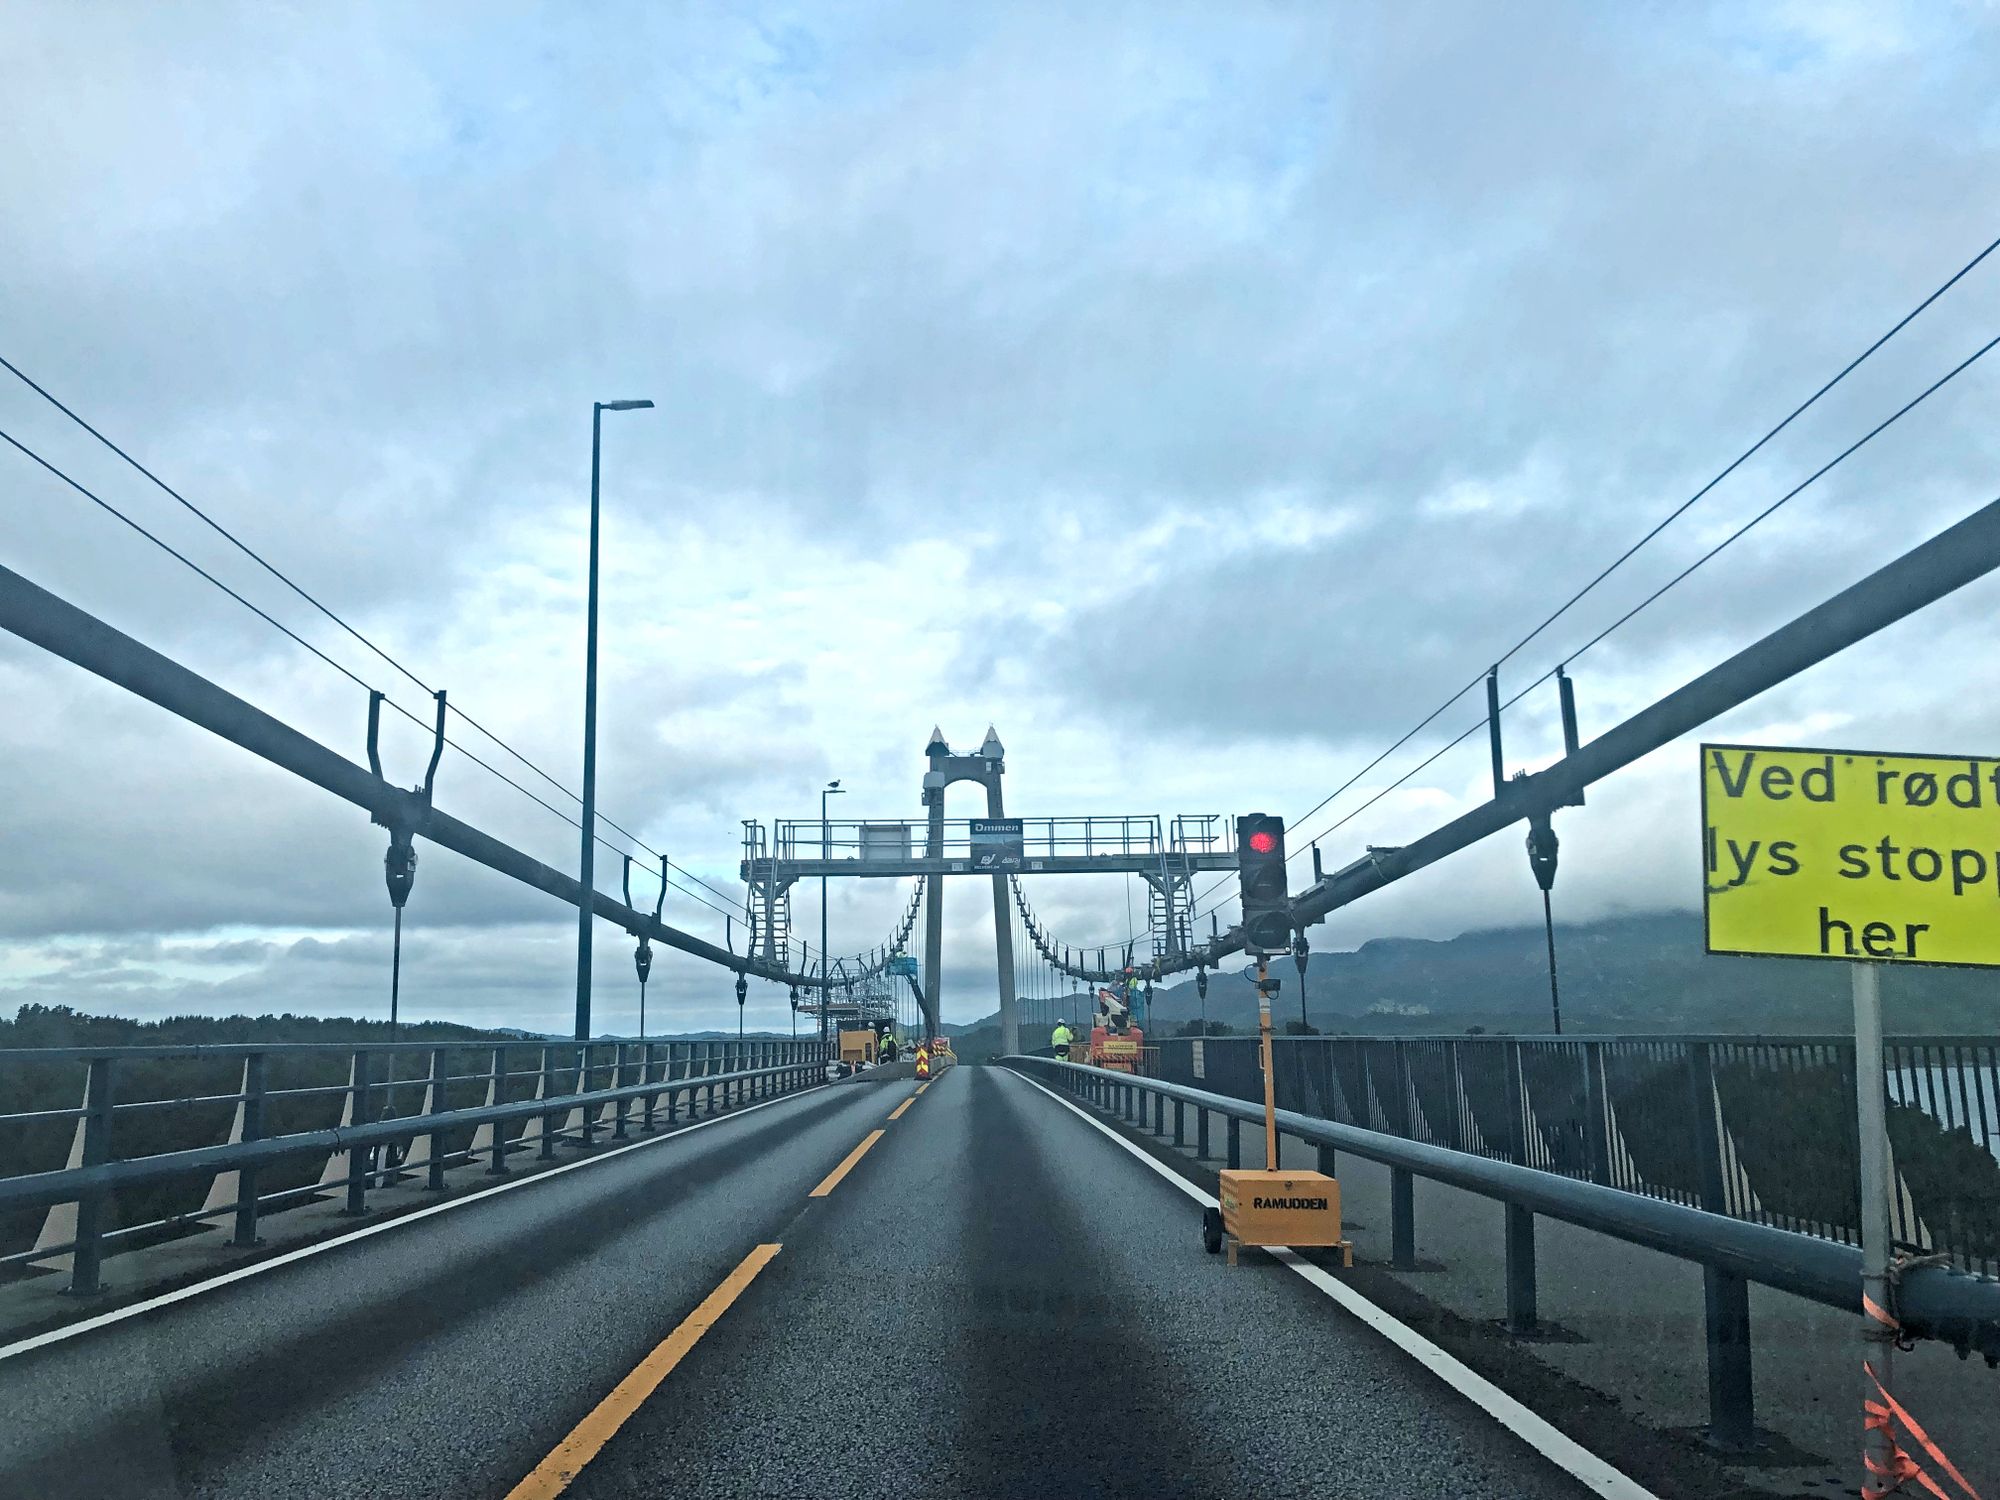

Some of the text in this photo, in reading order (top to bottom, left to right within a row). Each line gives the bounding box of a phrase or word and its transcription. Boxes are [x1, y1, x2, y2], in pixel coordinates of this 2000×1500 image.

[1712, 751, 1836, 802] Ved
[1708, 826, 2000, 897] lys stop
[1818, 906, 1931, 958] her
[1253, 1197, 1329, 1211] RAMUDDEN
